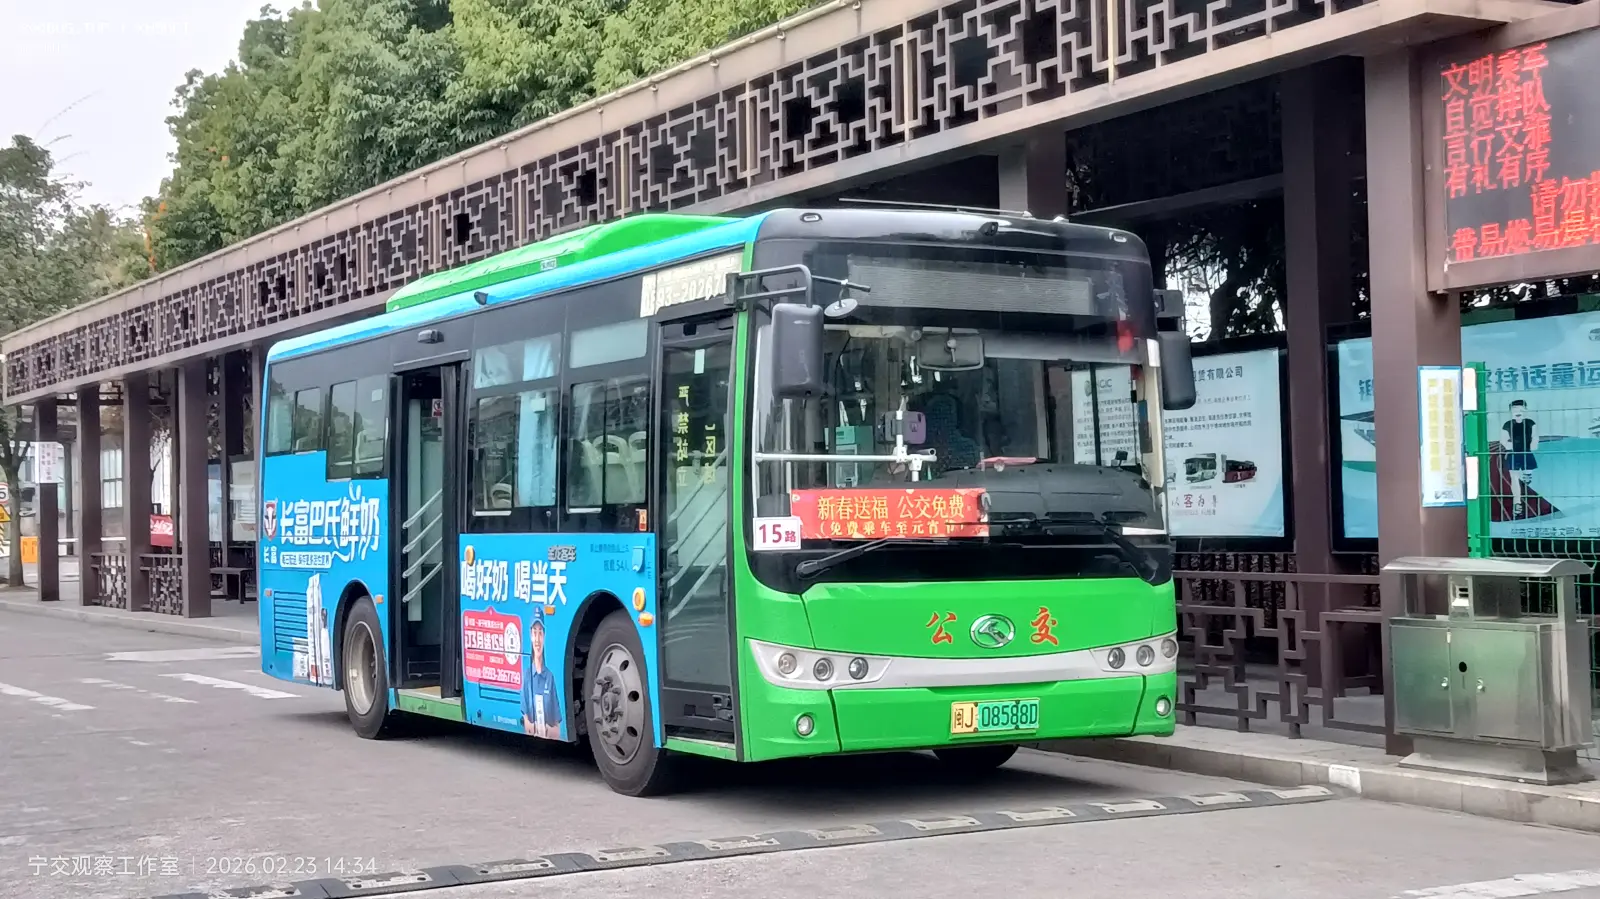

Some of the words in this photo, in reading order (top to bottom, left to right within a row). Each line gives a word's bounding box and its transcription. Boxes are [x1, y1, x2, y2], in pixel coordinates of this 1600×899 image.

[817, 495, 889, 520] 新春送福
[898, 494, 965, 519] 公交免费
[758, 523, 796, 544] 15路
[514, 560, 568, 606] 喝当天
[926, 611, 957, 645] 公
[1030, 605, 1059, 646] 交
